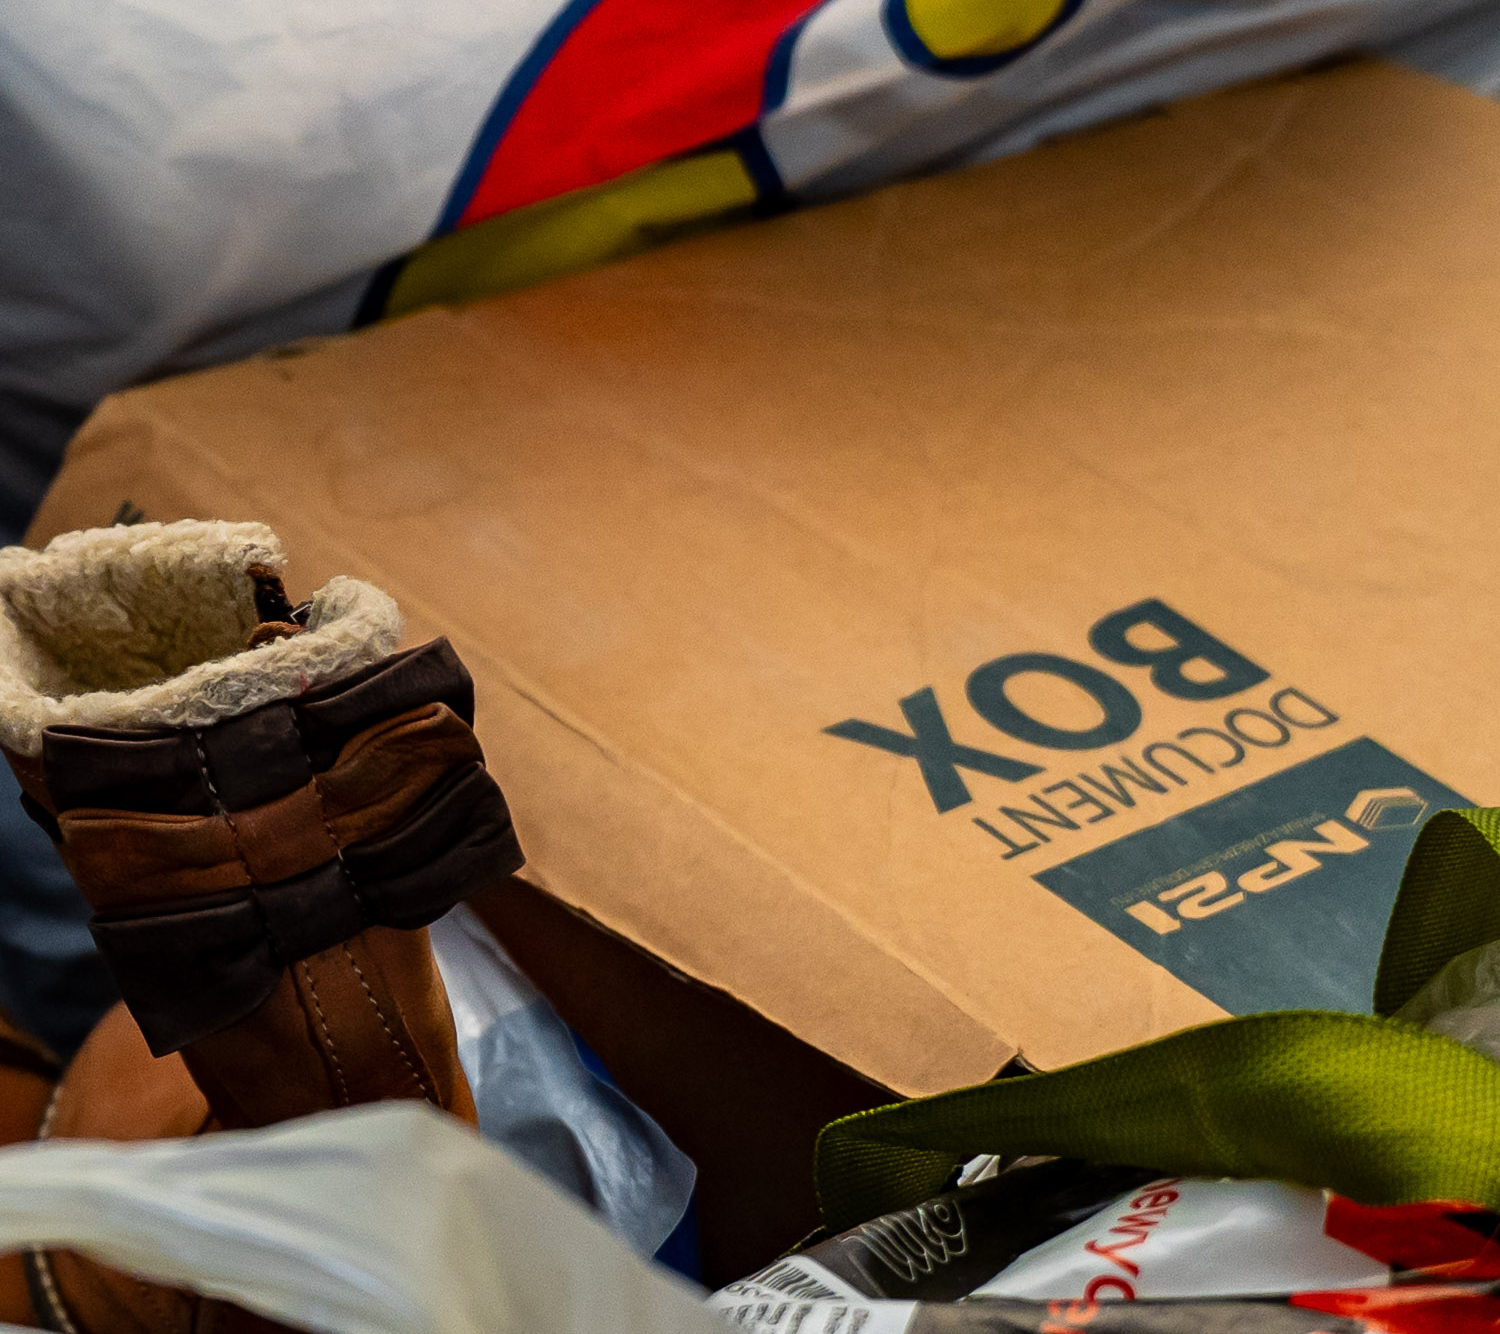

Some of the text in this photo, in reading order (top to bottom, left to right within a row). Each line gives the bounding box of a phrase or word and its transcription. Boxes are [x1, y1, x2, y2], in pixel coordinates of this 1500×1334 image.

[821, 597, 1273, 815] BOX
[971, 686, 1340, 860] DOCUMENT
[1124, 819, 1370, 935] NP21
